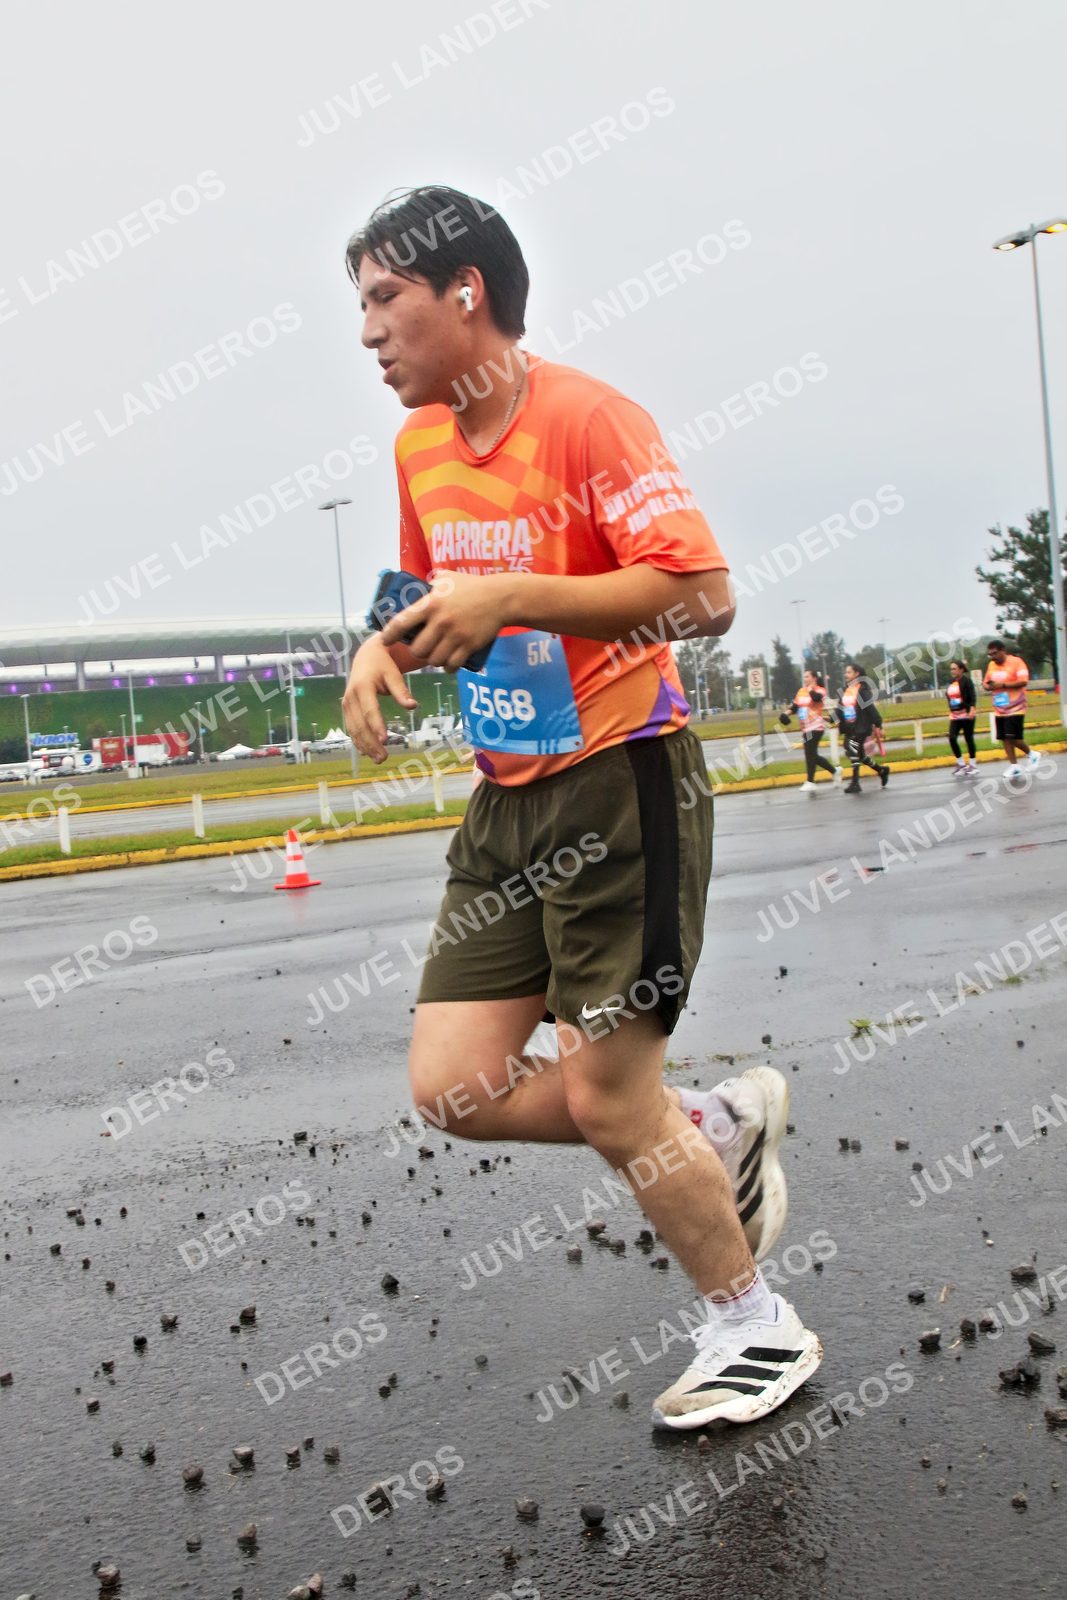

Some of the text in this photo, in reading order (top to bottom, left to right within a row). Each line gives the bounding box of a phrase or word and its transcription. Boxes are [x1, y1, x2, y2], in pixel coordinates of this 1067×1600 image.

[431, 518, 532, 563] CARRERA
[527, 638, 553, 666] 5K
[466, 682, 537, 721] 2568
